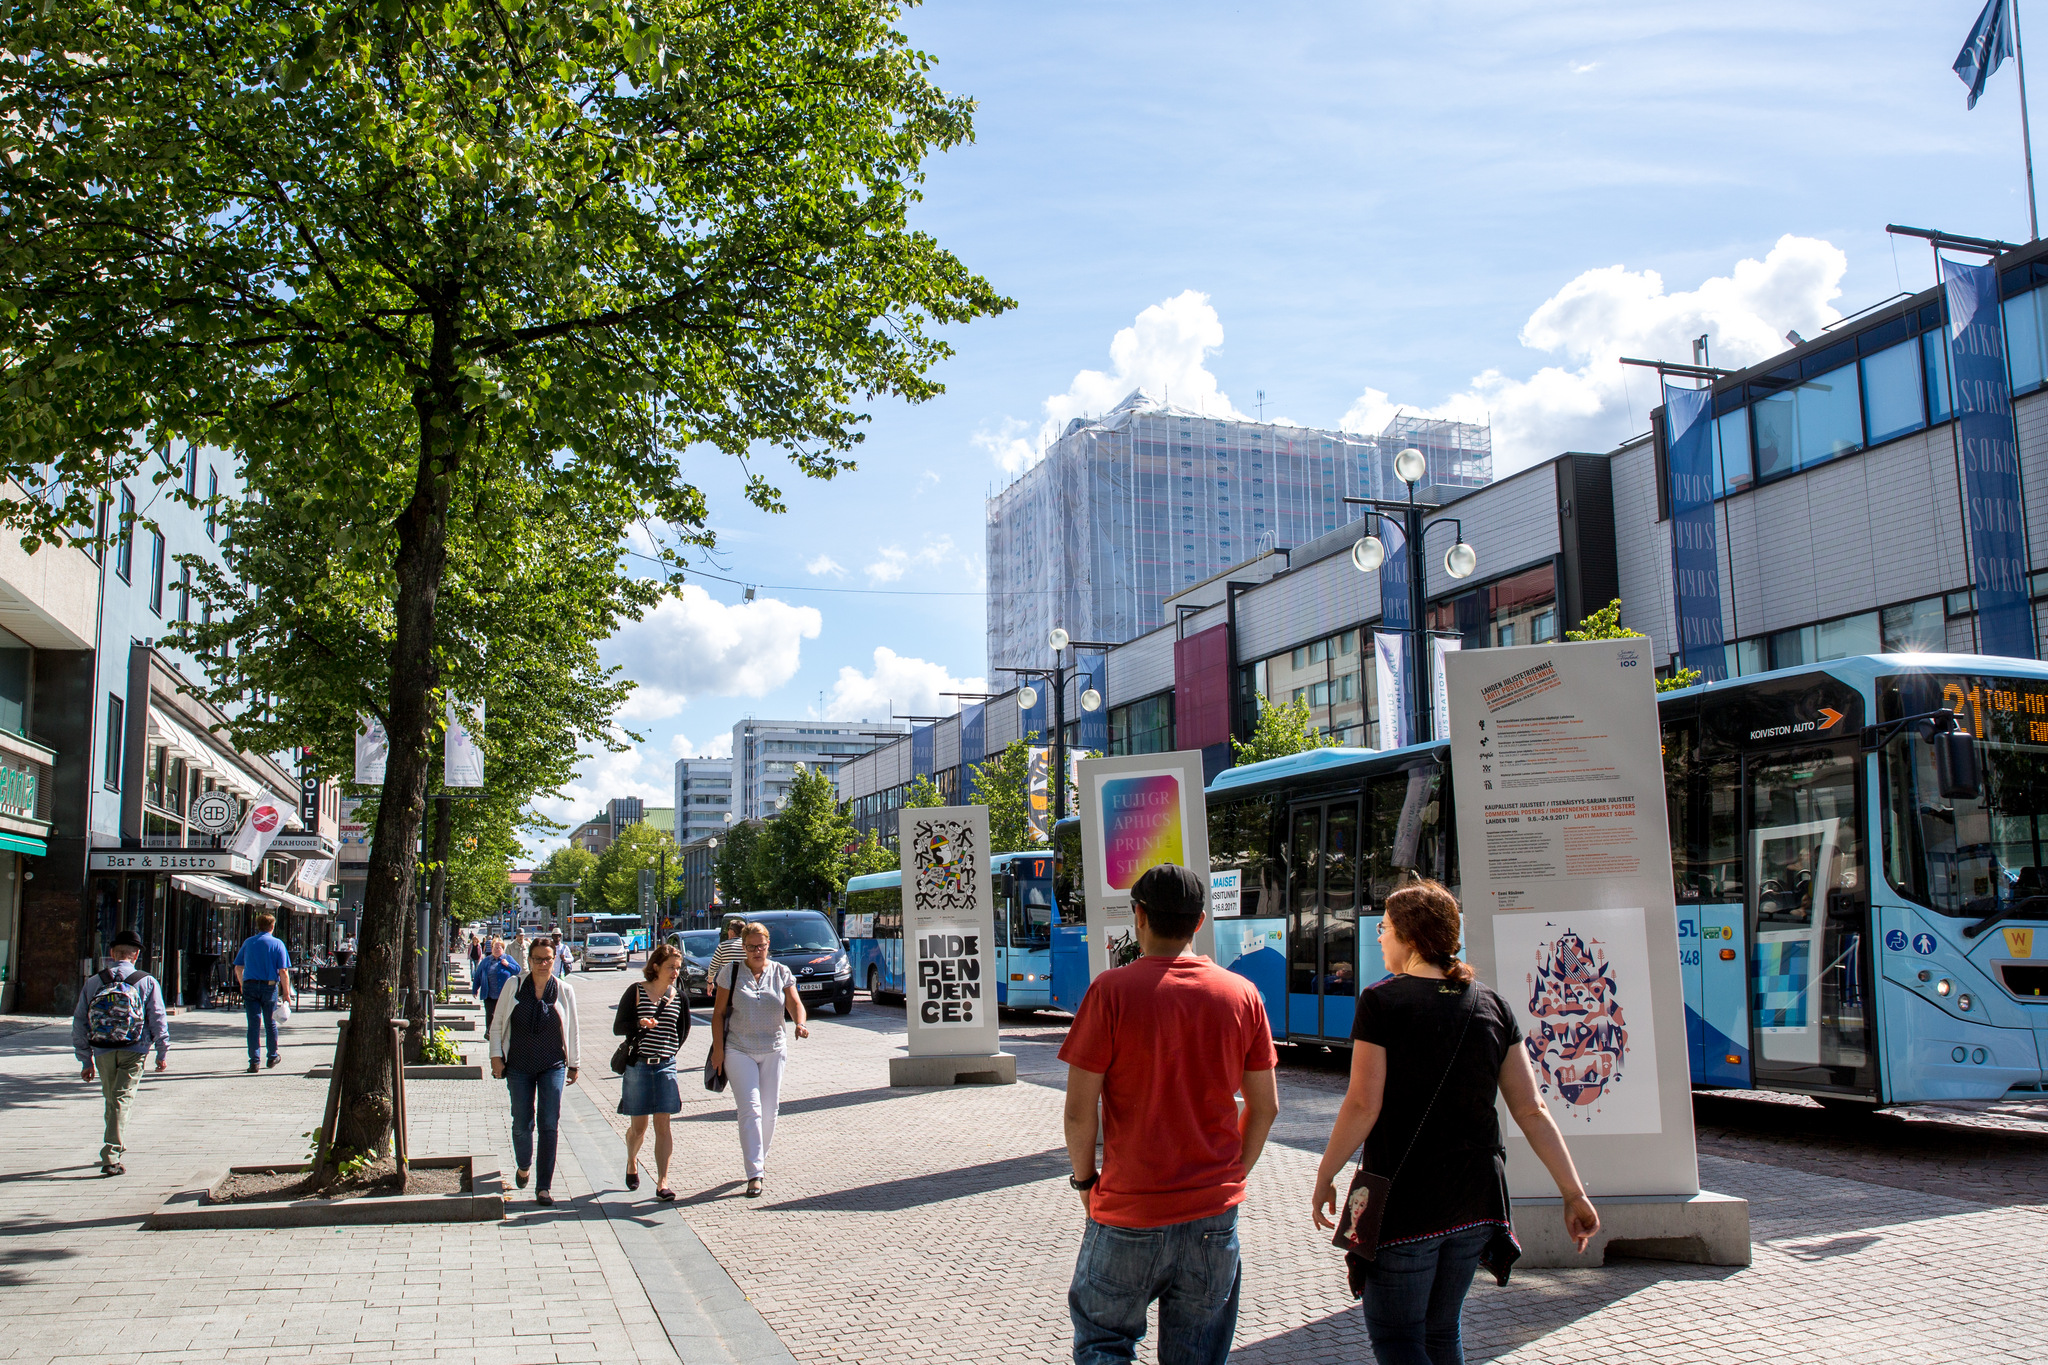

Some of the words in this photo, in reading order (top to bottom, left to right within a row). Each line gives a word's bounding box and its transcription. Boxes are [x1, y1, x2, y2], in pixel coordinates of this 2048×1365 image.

[1620, 660, 1637, 668] 100
[1480, 681, 1504, 695] LAHDEN
[1503, 660, 1554, 687] JULISTETRIENNALE
[1483, 690, 1501, 702] LAHTI
[1501, 680, 1525, 694] POSTER
[1525, 667, 1557, 684] TRIENNIAL
[1943, 683, 1984, 739] 21
[1984, 689, 2048, 714] TORI-MA
[1750, 725, 1791, 740] KOIVISTON
[1793, 721, 1816, 734] AUTO
[1484, 803, 1519, 811] KAUPALLISET
[1519, 801, 1546, 809] JULISTEET
[1550, 798, 1607, 807] ITSENÄISYYS-SARJAN
[1484, 810, 1520, 818] COMMERCIAL
[1549, 806, 1590, 814] INDEPENDENCE
[1113, 812, 1171, 829] APHICS
[1590, 811, 1613, 819] MARKET
[1115, 834, 1163, 851] PRINT
[107, 855, 136, 867] Bar
[141, 857, 152, 867] &
[160, 856, 216, 868] Bistro
[1034, 860, 1046, 877] 17
[1211, 875, 1237, 889] MAISET
[918, 934, 979, 959] INDE
[2011, 932, 2026, 946] W
[918, 958, 981, 988] PEN
[927, 978, 981, 1001] DEN
